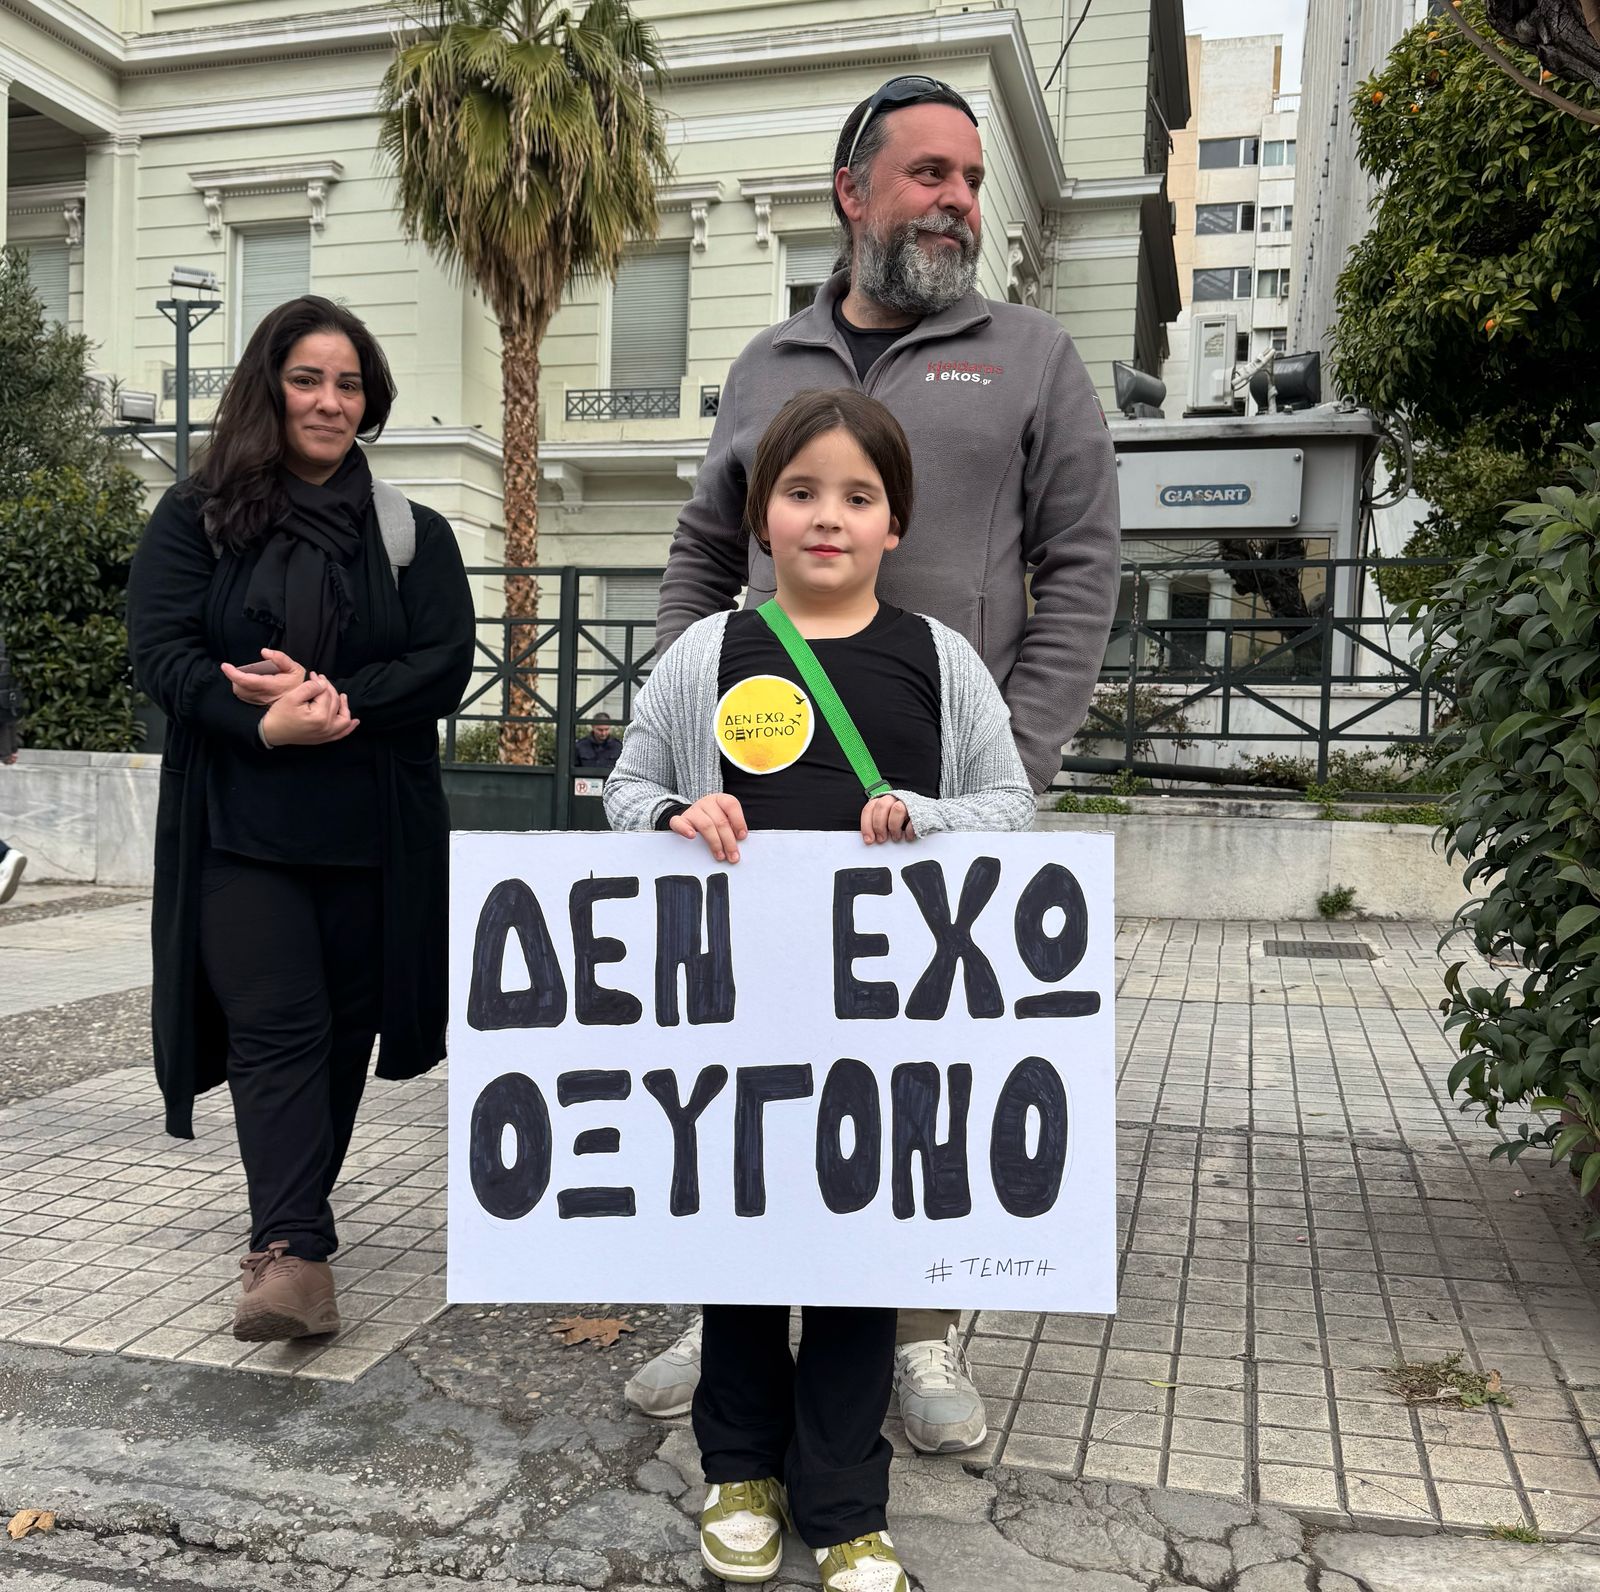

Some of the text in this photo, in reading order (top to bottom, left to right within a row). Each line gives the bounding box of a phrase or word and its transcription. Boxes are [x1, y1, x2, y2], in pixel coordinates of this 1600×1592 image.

[1164, 488, 1247, 502] GLASSART
[725, 711, 785, 726] ΔΕΝ ΕΧΩ
[724, 725, 795, 742] ΟΞΥΓΟΝΟ
[467, 856, 1101, 1032] ΔΕΝ ΕΧΩ
[469, 1056, 1068, 1221] ΟΞΥΓΟΝΟ
